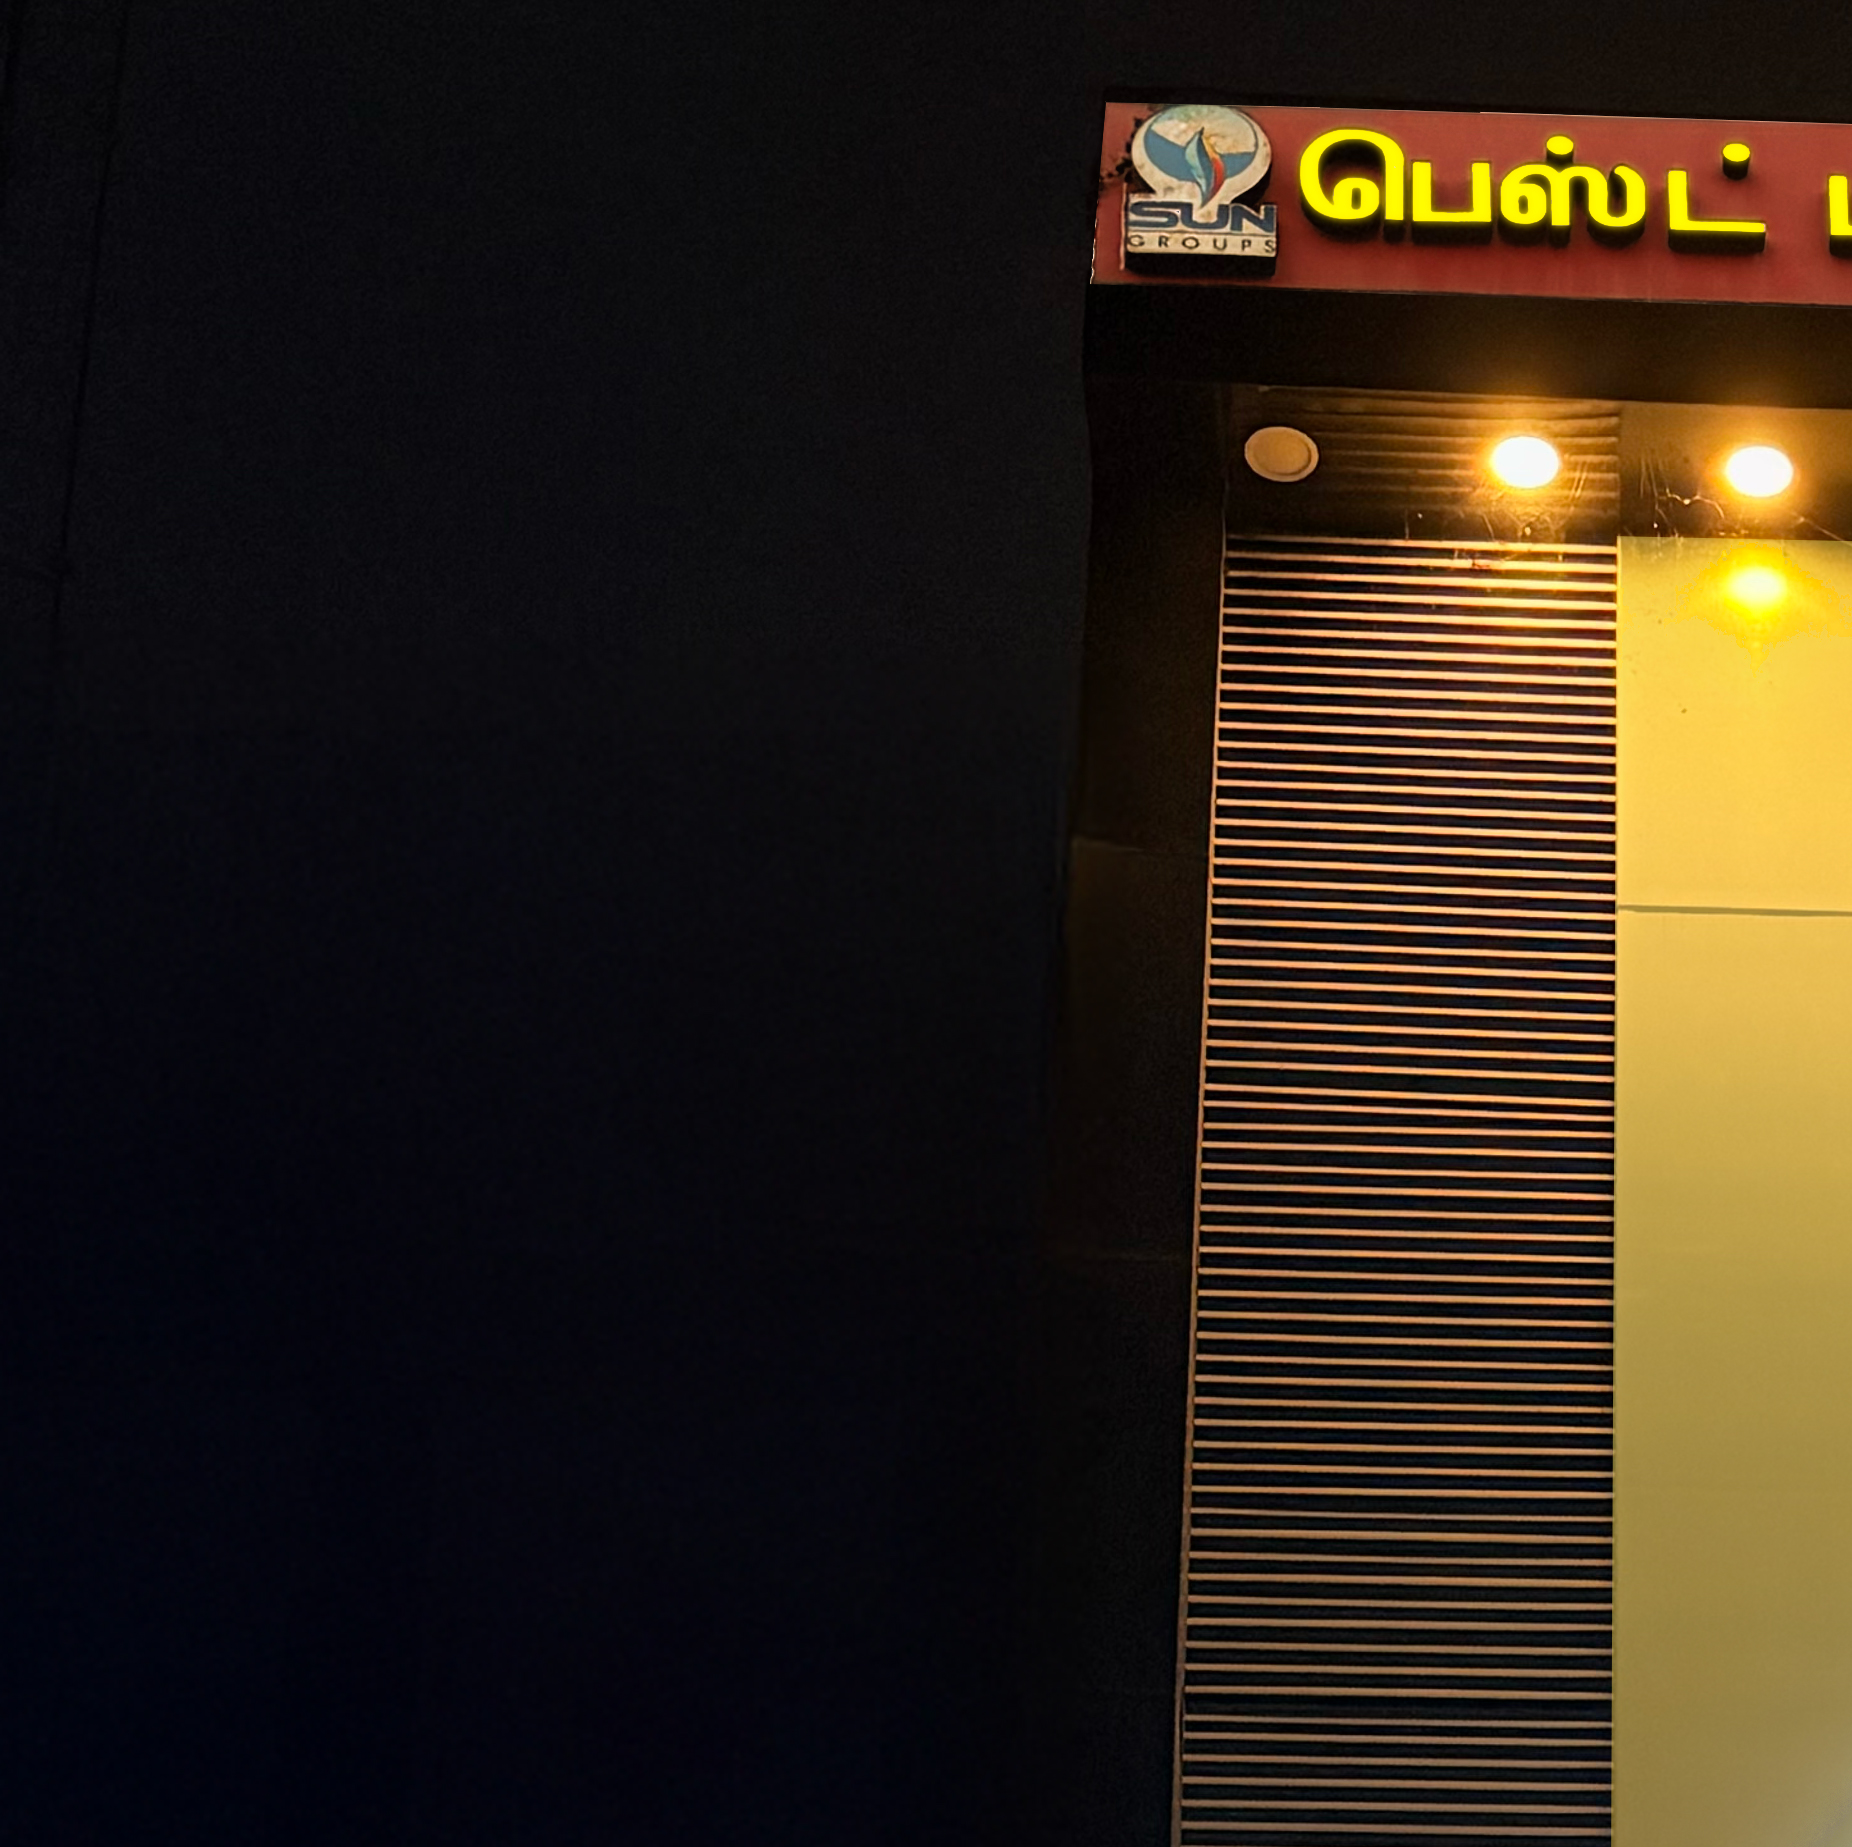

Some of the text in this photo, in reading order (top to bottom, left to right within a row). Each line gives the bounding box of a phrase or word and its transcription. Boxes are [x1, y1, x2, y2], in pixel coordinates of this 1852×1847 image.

[1299, 127, 1767, 235] பெஸ்ட்
[1128, 201, 1276, 233] SUN
[1128, 234, 1277, 254] GROUPS
